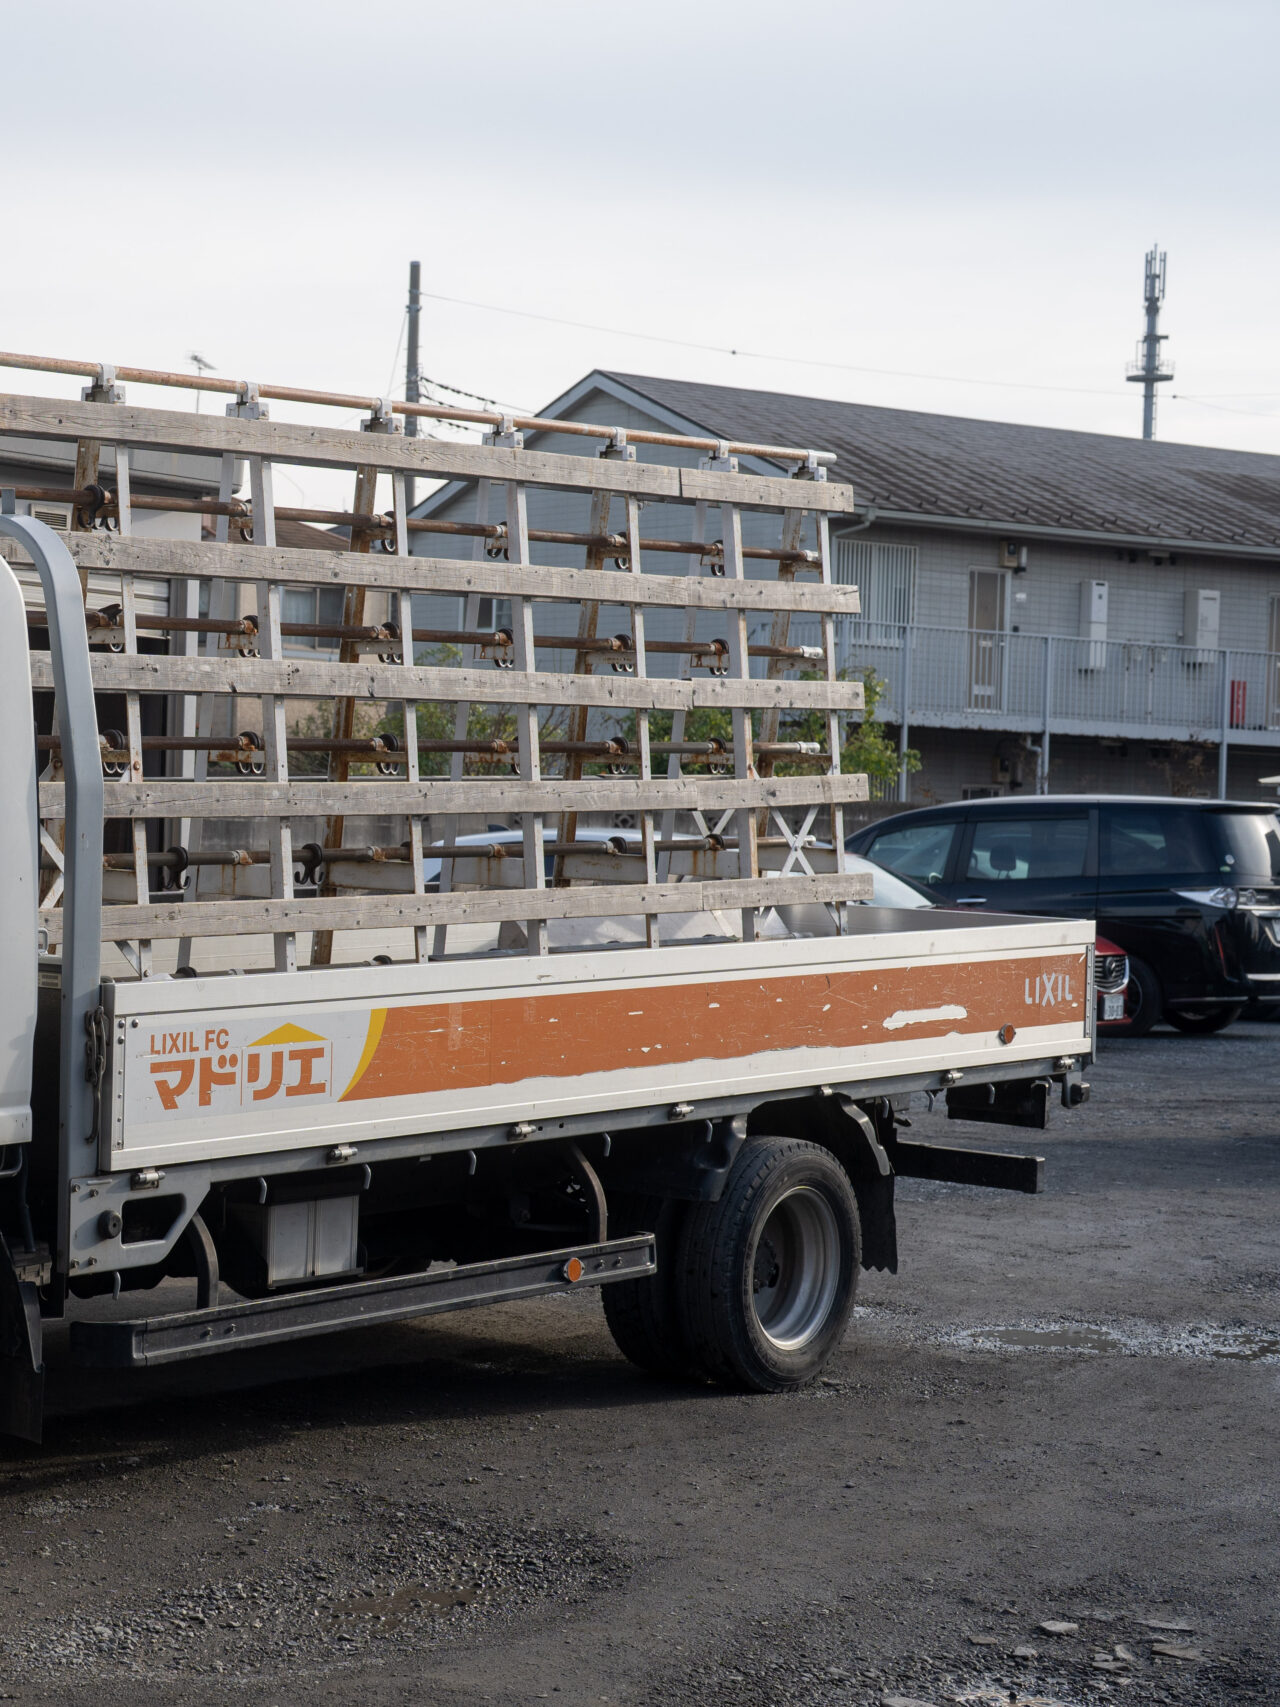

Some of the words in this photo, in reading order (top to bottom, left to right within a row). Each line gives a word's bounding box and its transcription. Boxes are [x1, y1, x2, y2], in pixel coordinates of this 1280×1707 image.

[1024, 972, 1073, 1007] LIXIL
[150, 1031, 199, 1055] LIXIL
[205, 1028, 230, 1051] FC
[150, 1047, 326, 1110] マドリエ
